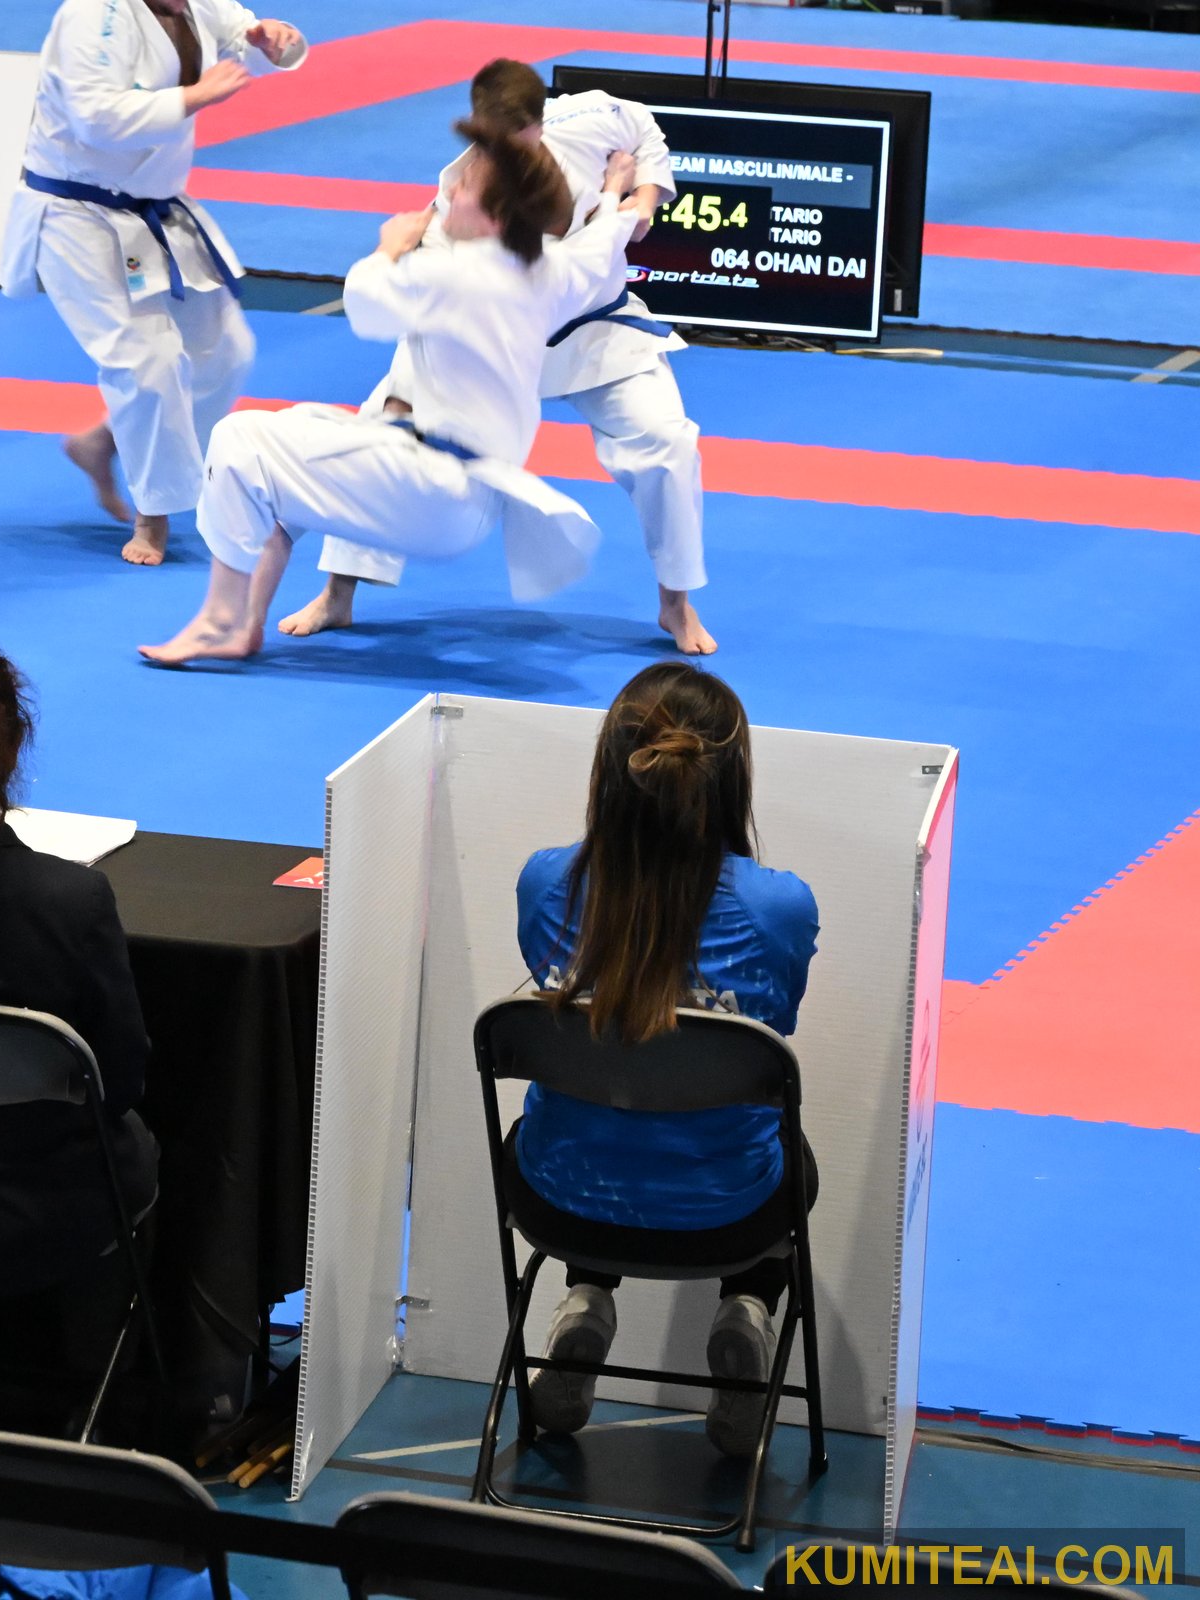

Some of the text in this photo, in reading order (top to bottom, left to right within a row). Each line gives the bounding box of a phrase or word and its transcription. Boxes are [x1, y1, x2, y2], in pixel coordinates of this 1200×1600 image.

[668, 155, 706, 173] EAM
[708, 159, 844, 183] MASCULIN/MALE
[650, 193, 749, 232] :45.4
[770, 206, 823, 225] TARIO
[769, 227, 822, 246] TARIO
[711, 248, 867, 279] 064 OHAN DAI
